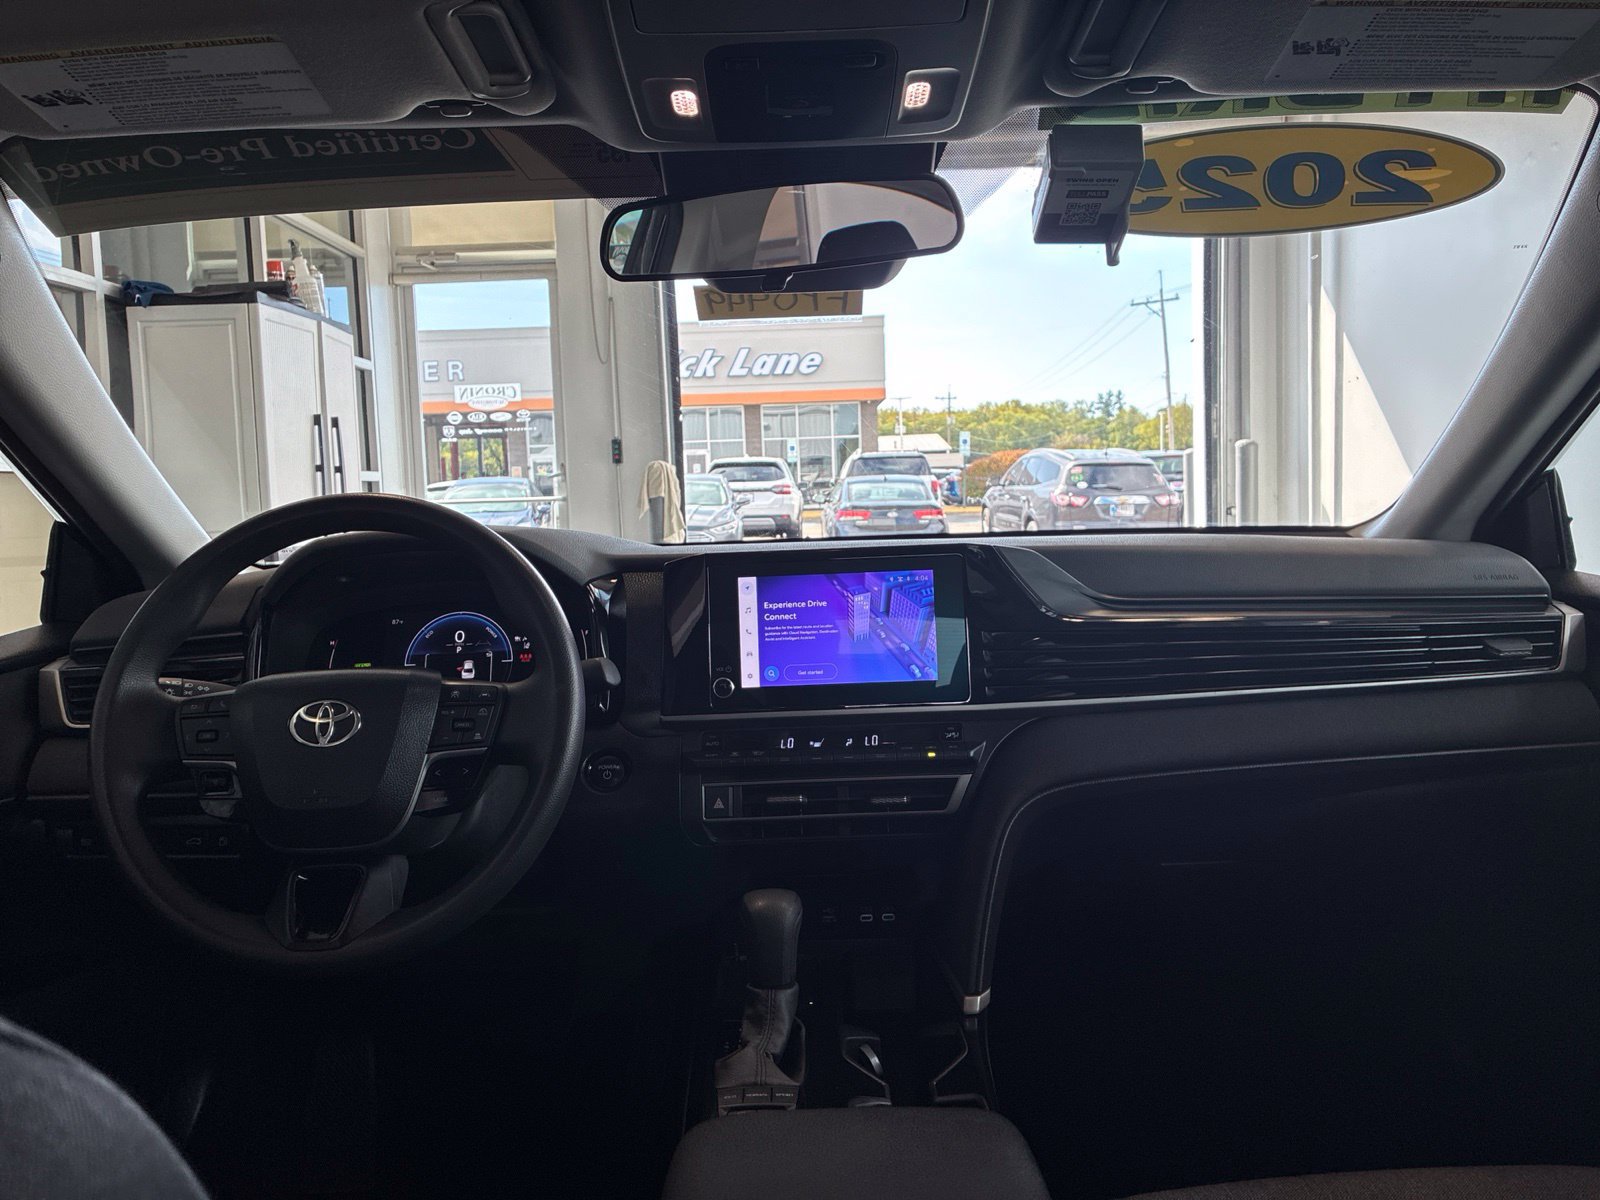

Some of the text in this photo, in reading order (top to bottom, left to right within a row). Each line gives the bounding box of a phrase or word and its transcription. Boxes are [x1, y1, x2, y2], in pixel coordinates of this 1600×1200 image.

[728, 347, 823, 378] Lane
[763, 599, 828, 610] Experience Drive
[764, 612, 797, 621] Connect
[454, 630, 465, 643] 0
[456, 646, 462, 654] P
